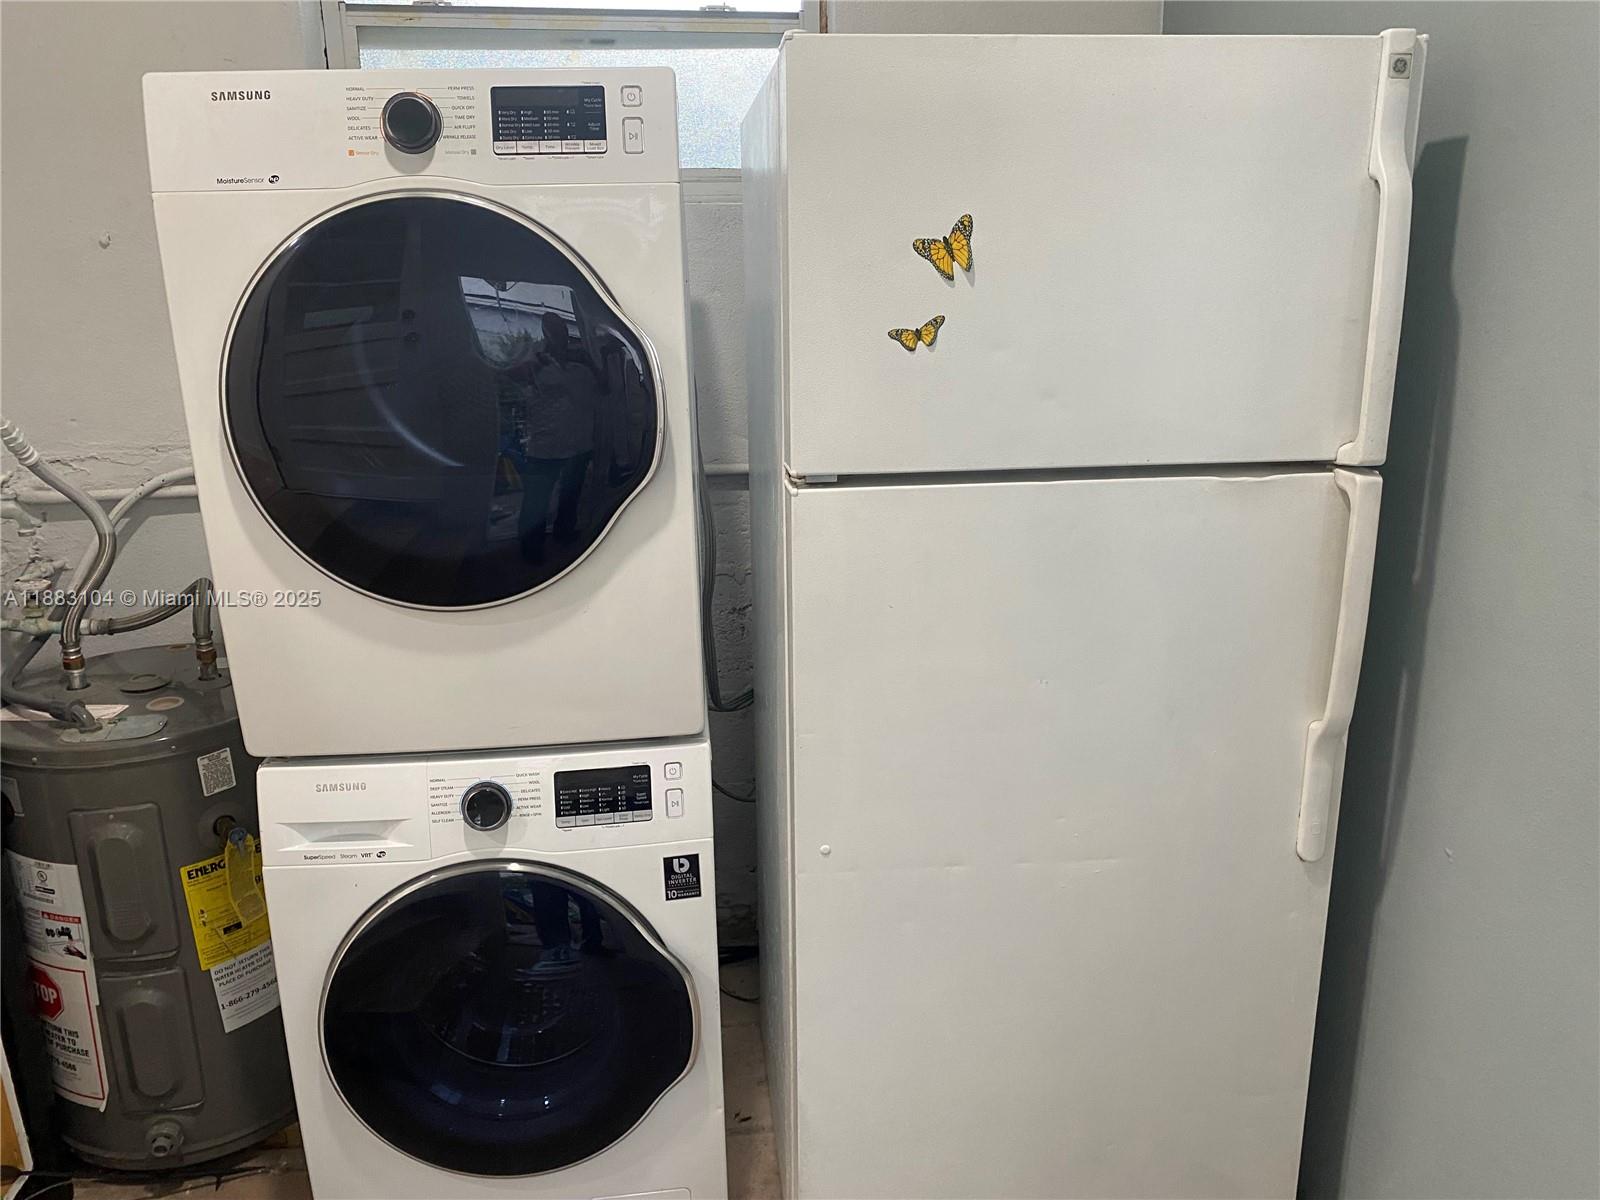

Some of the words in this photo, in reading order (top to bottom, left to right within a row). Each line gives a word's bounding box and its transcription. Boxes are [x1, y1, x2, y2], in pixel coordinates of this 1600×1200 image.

[211, 89, 272, 102] SAMSUNG
[216, 177, 265, 185] MoistureSensor
[315, 782, 367, 793] SAMSUNG
[187, 858, 227, 880] ENERG
[668, 877, 697, 885] INVERTER
[667, 889, 677, 899] 10
[224, 961, 236, 970] NOT
[214, 971, 234, 982] WATER
[218, 977, 237, 987] PLACE
[33, 981, 58, 1004] TOP
[63, 1028, 79, 1038] THIS
[66, 1037, 76, 1046] TO
[55, 1043, 89, 1058] PURCHASE
